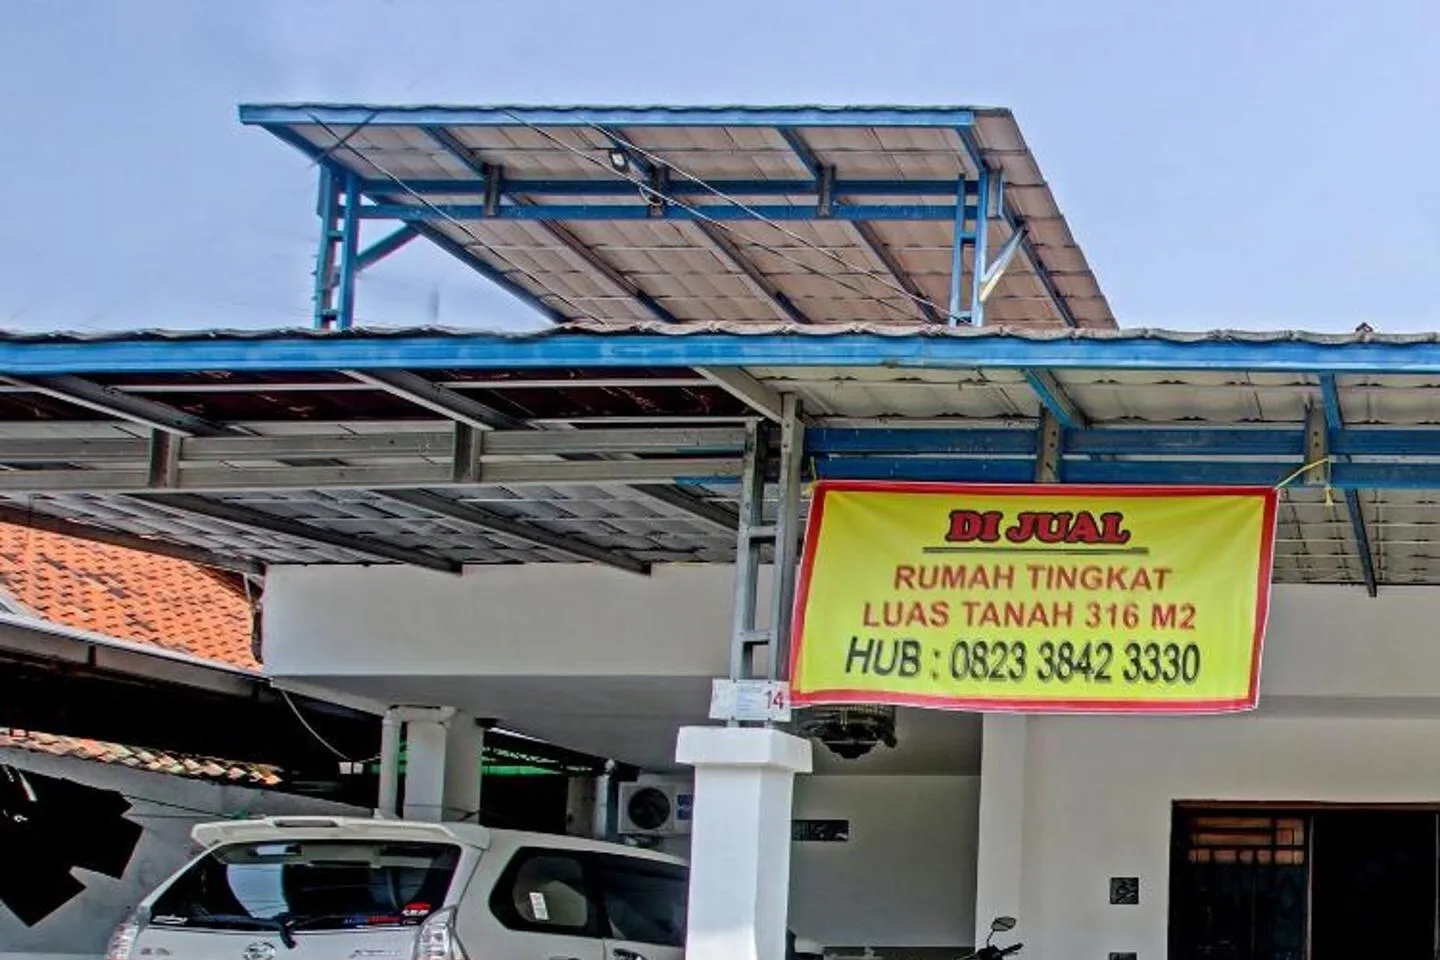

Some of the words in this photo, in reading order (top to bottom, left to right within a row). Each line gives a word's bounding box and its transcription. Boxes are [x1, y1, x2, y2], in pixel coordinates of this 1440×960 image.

[946, 510, 1004, 544] DI
[1005, 511, 1131, 545] JUAL
[893, 565, 1015, 591] RUMAH
[1026, 565, 1173, 591] TINGKAT
[863, 601, 949, 628] LUAS
[962, 601, 1074, 628] TANAH
[1085, 602, 1139, 629] 316
[1150, 602, 1196, 630] M2
[845, 636, 922, 678] HUB
[948, 639, 1029, 683] 0823
[1036, 640, 1114, 684] 3842
[1122, 641, 1201, 685] 3330
